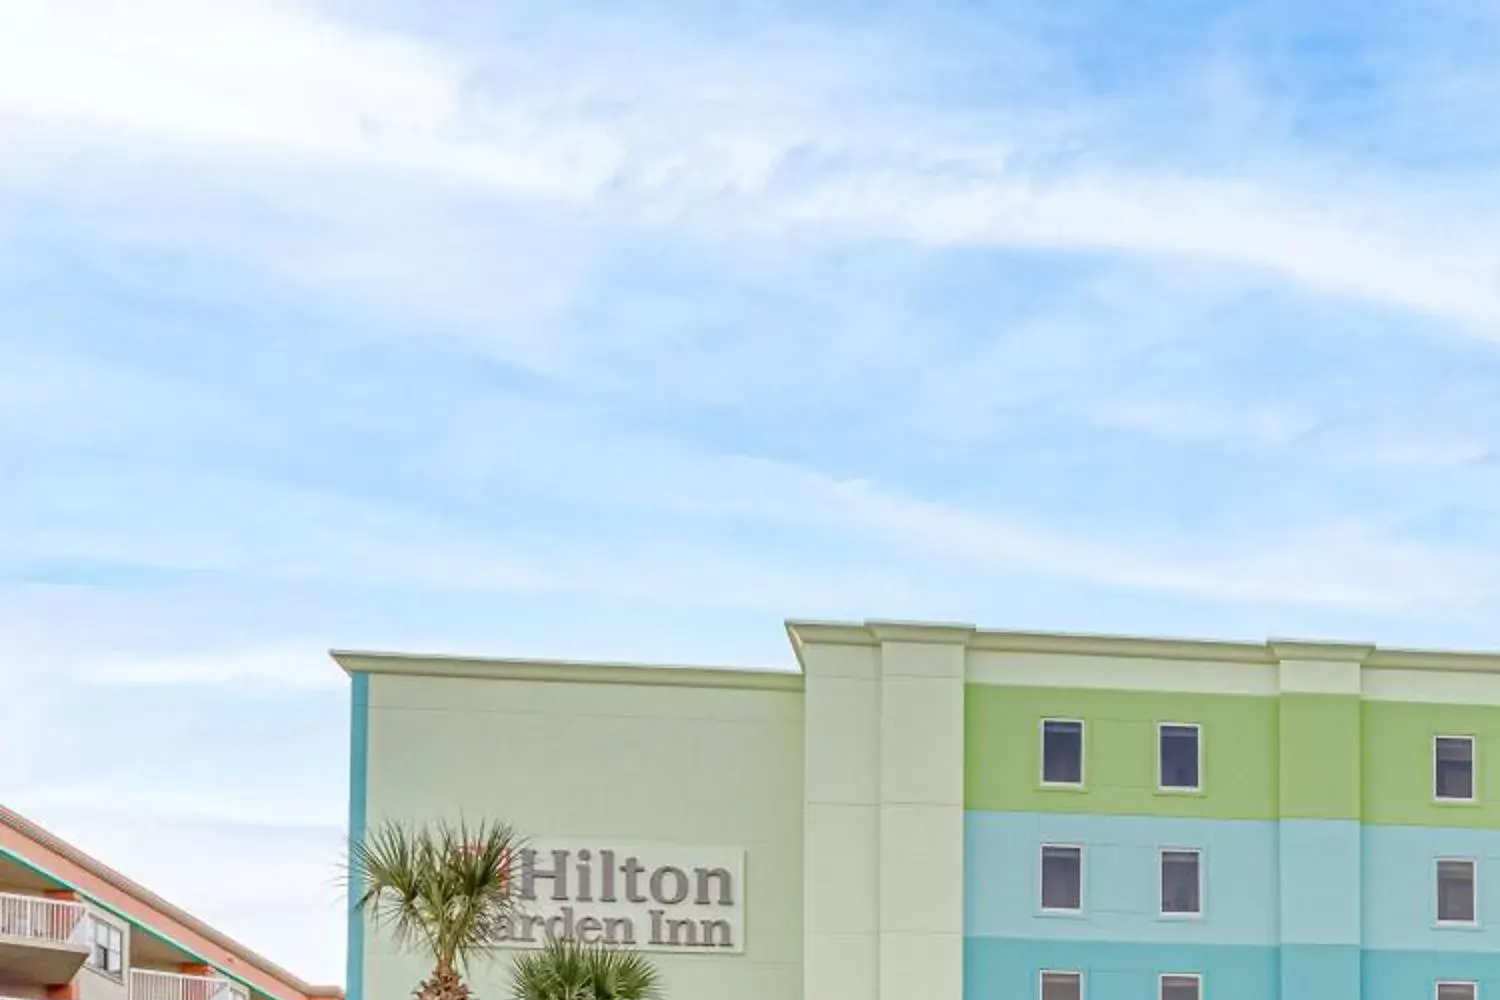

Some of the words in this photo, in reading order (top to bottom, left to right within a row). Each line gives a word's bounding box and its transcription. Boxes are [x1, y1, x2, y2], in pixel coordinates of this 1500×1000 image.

[518, 848, 735, 905] Hilton
[478, 906, 636, 945] arden
[648, 909, 734, 947] Inn
